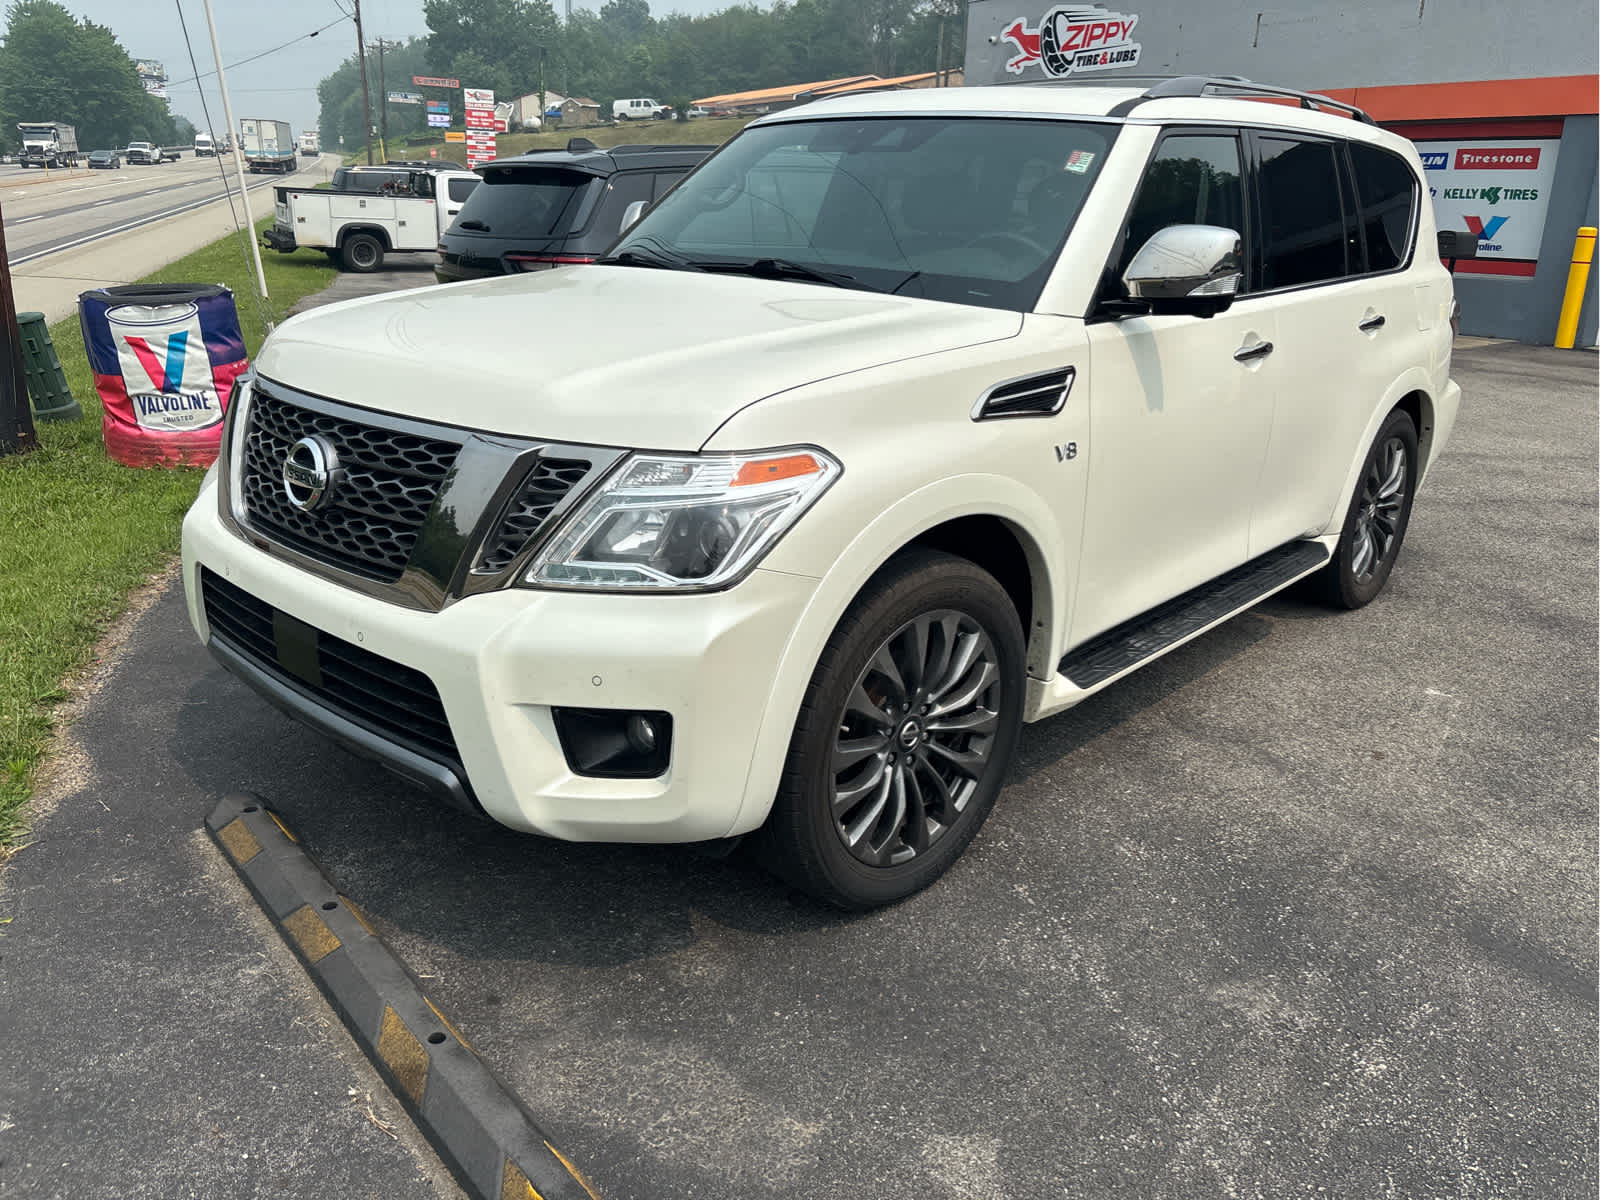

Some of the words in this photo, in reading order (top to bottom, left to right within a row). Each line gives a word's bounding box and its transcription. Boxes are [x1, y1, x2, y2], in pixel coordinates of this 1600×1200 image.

[1060, 20, 1134, 52] ZIPPY
[1462, 153, 1534, 166] Firestone
[1443, 188, 1479, 199] KELLY
[1503, 189, 1539, 201] TIRES
[137, 390, 212, 416] VALVOLINE
[1054, 442, 1077, 463] V8
